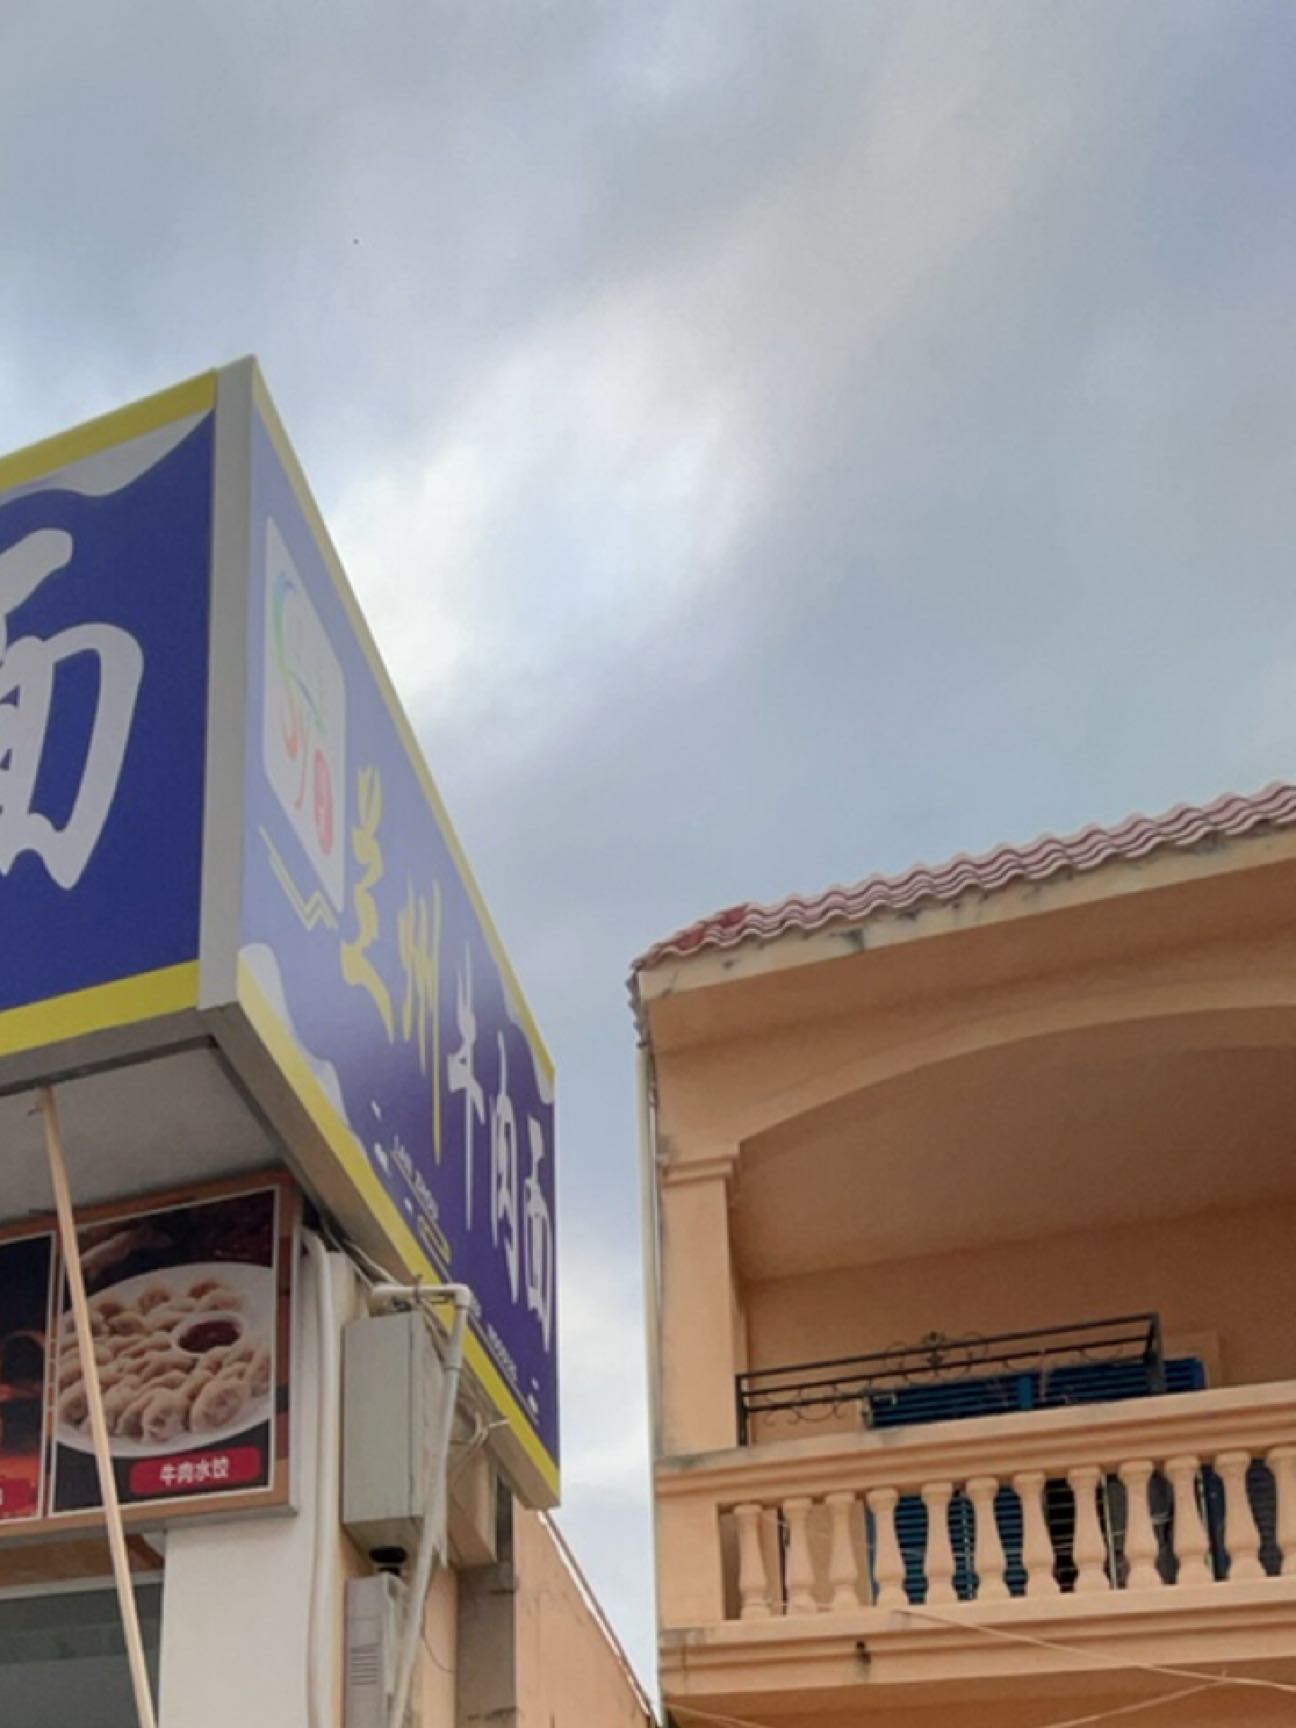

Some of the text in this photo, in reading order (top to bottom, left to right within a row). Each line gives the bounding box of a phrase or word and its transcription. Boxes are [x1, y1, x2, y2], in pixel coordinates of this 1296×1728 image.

[339, 763, 553, 1353] 兰州牛肉面
[159, 1455, 230, 1488] 牛肉水饺
